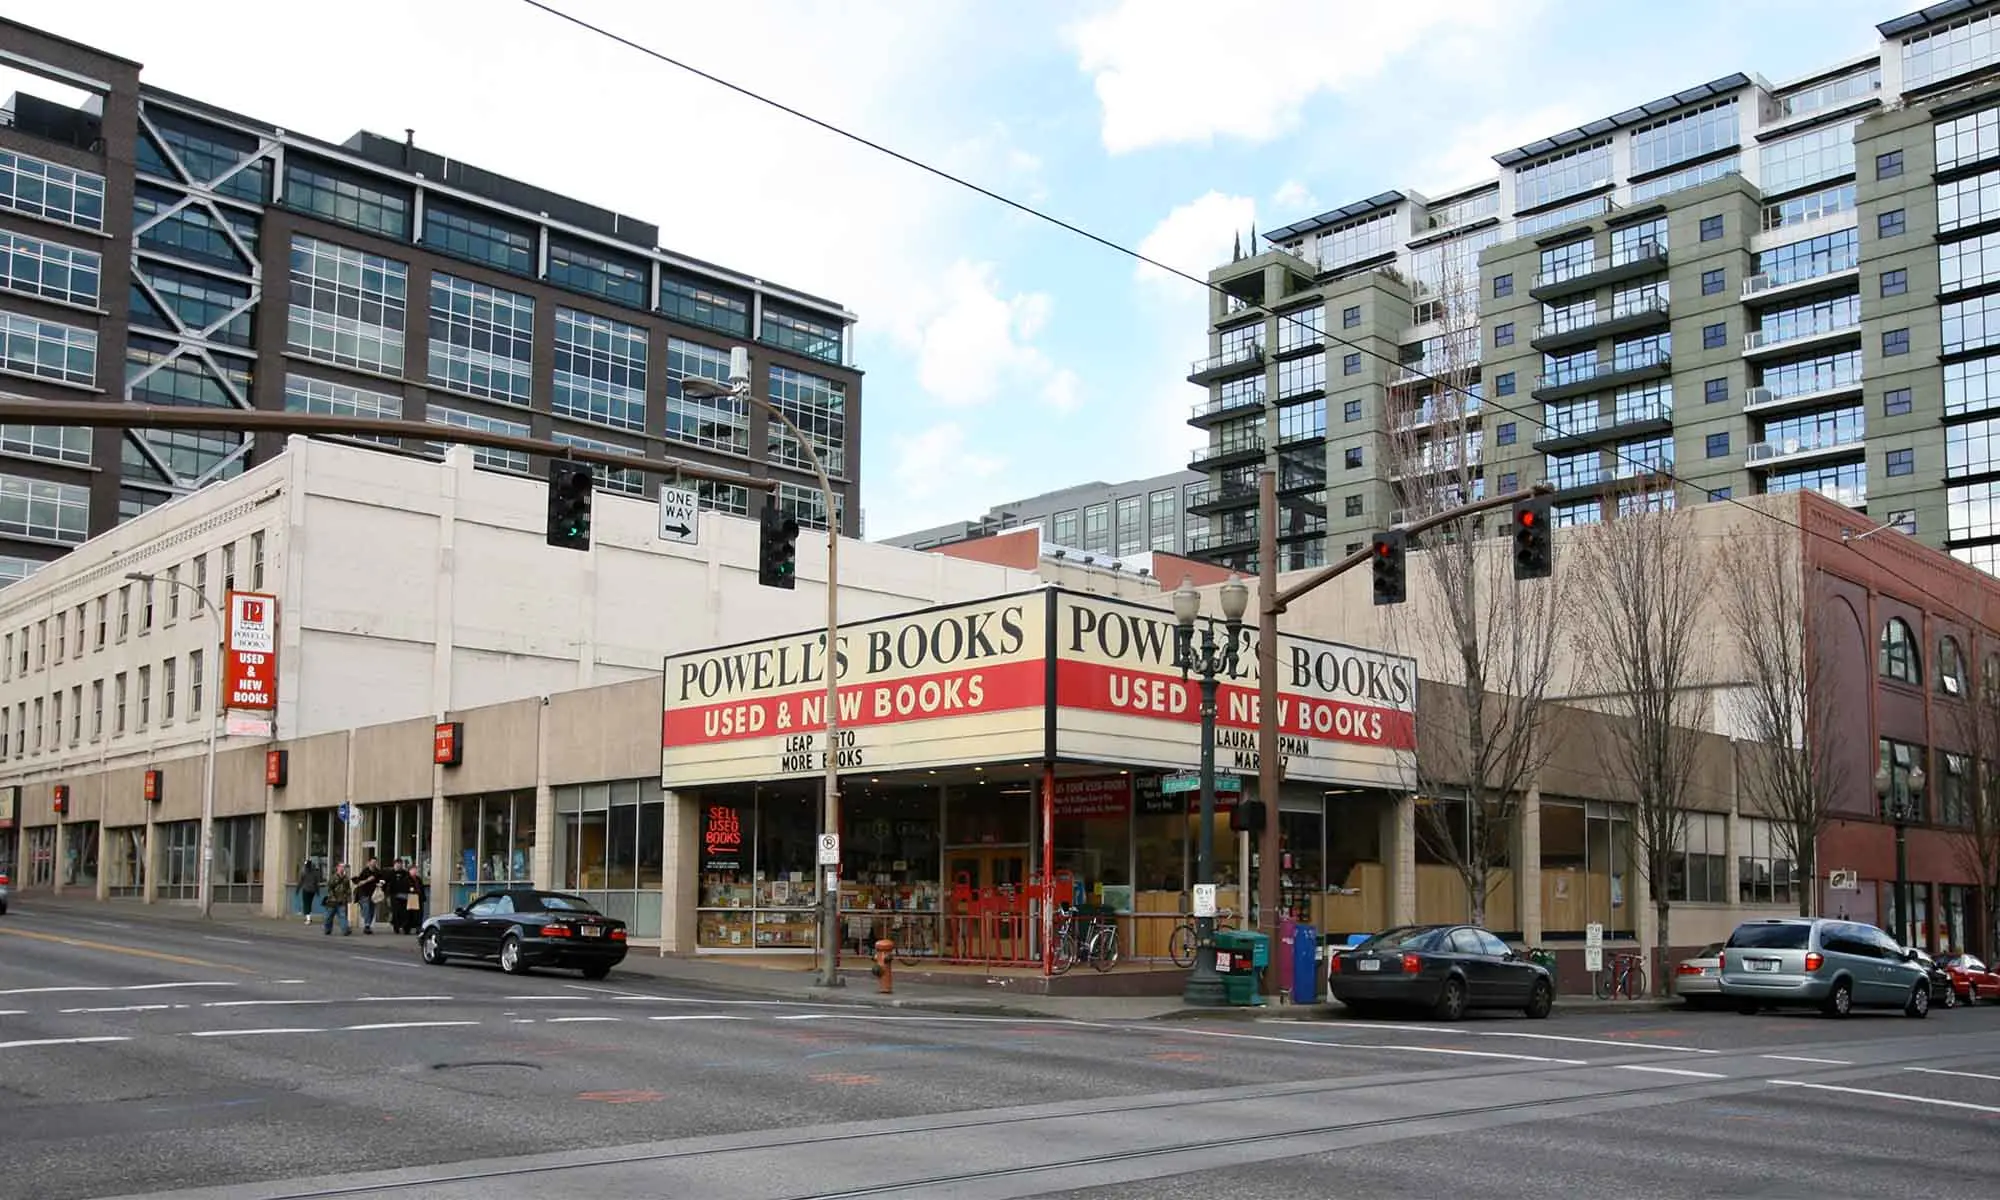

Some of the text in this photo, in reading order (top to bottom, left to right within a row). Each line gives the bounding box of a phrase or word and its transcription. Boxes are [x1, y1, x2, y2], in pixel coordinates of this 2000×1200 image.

[667, 491, 693, 506] ONE
[665, 505, 693, 520] WAY
[239, 652, 265, 665] USED
[680, 605, 1025, 702] POWELL'S BOOKS
[247, 665, 256, 677] &
[1290, 646, 1408, 704] BOOKS
[239, 679, 263, 691] NEW
[233, 692, 269, 704] BOOKS
[704, 704, 765, 738] USED
[776, 702, 793, 729] &
[874, 674, 985, 718] BOOKS
[1109, 673, 1188, 714] USED
[1298, 701, 1382, 740] BOOKS
[786, 731, 856, 752] LEAP TO
[1216, 729, 1256, 749] LAURA
[782, 749, 863, 772] MORE BOKS
[710, 807, 738, 820] SELL
[710, 820, 739, 833] USED
[706, 832, 741, 845] BOOKS
